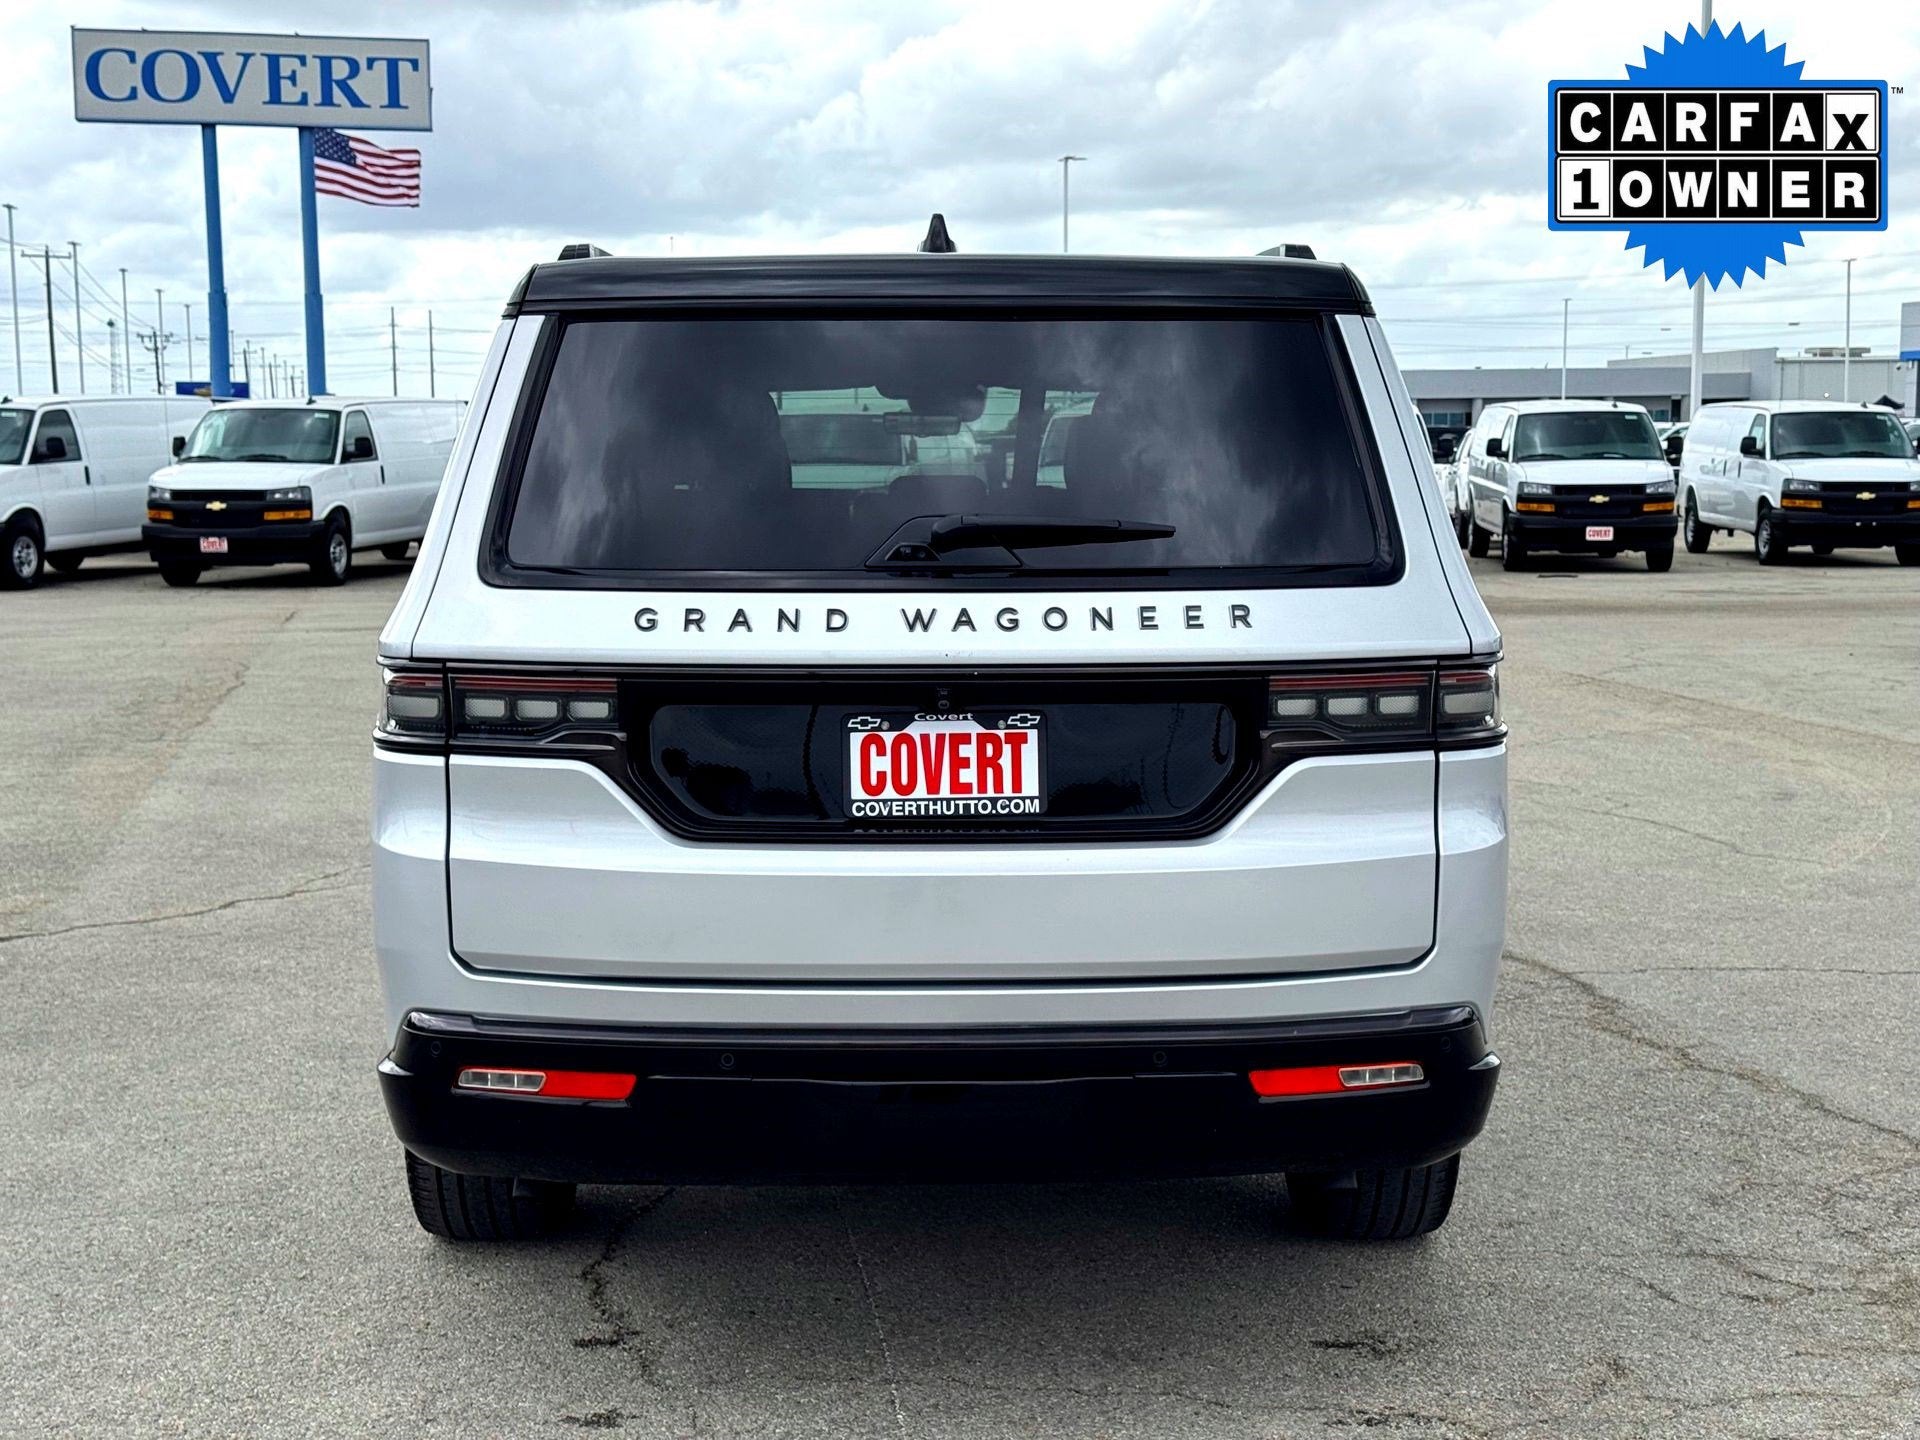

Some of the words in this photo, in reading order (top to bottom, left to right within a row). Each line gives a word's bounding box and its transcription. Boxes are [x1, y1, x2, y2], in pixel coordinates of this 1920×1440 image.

[85, 48, 419, 109] COVERT
[634, 607, 849, 633] GRAND
[900, 604, 1253, 632] WAGONEER
[914, 712, 974, 721] Covert
[860, 732, 1028, 797] COVERT
[851, 799, 1040, 817] COVERTHUTTO.COM
